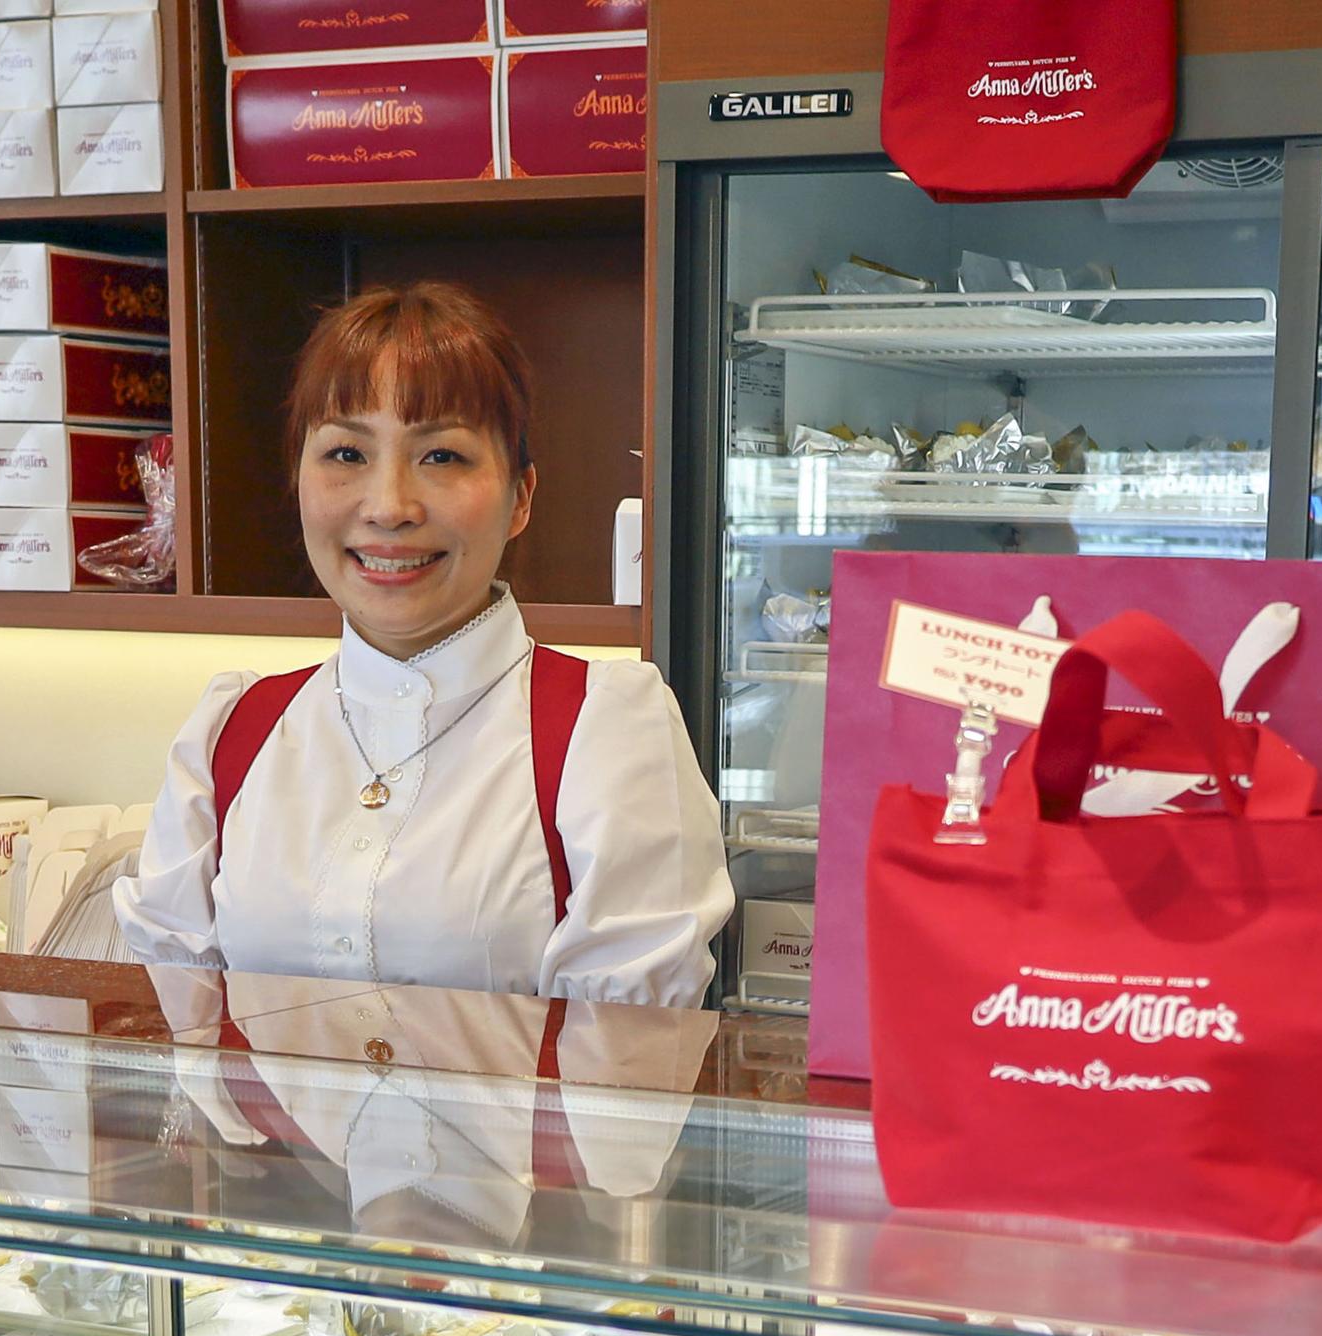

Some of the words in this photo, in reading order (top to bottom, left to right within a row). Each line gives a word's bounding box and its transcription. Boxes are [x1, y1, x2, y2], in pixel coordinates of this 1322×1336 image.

[967, 74, 1020, 97] Anna
[292, 104, 347, 131] Anna
[349, 100, 424, 131] Miller's
[573, 89, 634, 117] Anna
[722, 93, 838, 117] GALILEI
[920, 621, 1004, 651] LUNCH
[1010, 643, 1061, 663] TOT
[962, 673, 1025, 697] ¥990
[762, 940, 800, 956] Anna
[971, 983, 1082, 1031] Anna
